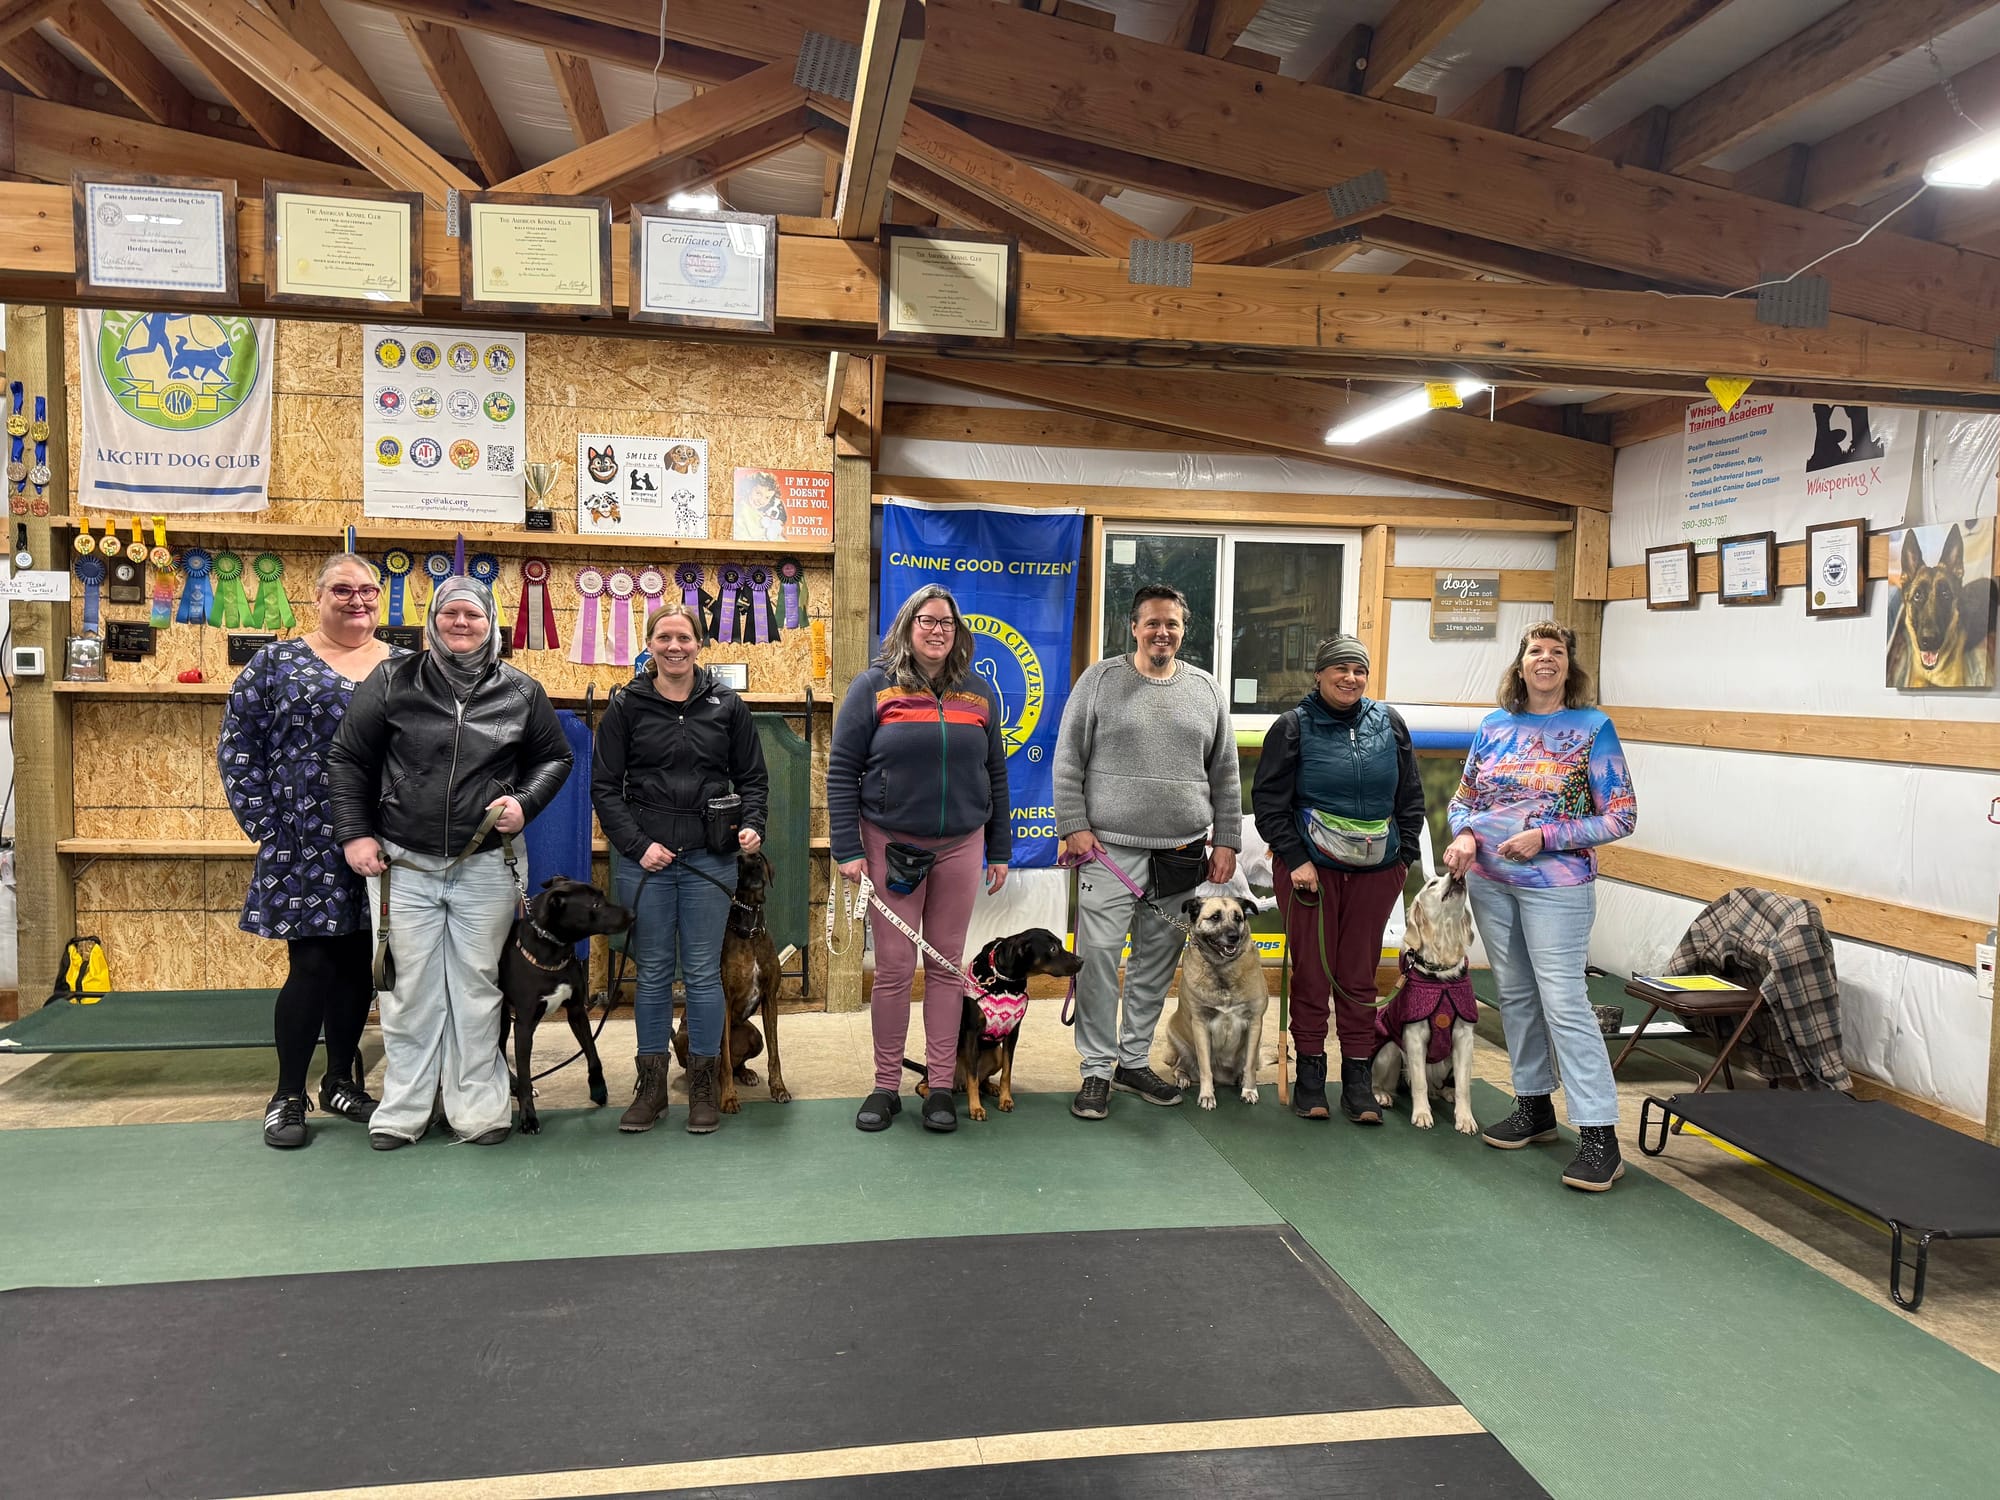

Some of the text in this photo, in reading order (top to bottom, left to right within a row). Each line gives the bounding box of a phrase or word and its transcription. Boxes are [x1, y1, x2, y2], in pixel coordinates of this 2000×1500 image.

[103, 193, 128, 201] Cascade
[128, 194, 159, 203] Australian
[179, 198, 190, 206] Dog
[661, 233, 710, 247] Certificate
[712, 238, 724, 248] of
[128, 245, 150, 254] Herding
[166, 391, 192, 415] AKC
[1689, 403, 1774, 433] Training Academy
[1749, 428, 1768, 438] Group
[418, 445, 433, 458] ATT
[626, 452, 658, 460] SMILES
[1714, 448, 1740, 458] classes!
[97, 447, 260, 469] AKC FIT DOG CLUB
[1712, 458, 1746, 470] Obedience,
[1745, 469, 1763, 478] Issues
[785, 477, 830, 487] IF MY DOG
[1746, 480, 1761, 488] Good
[1807, 466, 1882, 500] Whispering X
[790, 488, 825, 498] DOESN'T
[421, 497, 469, 507] cgc@akc.org
[786, 499, 808, 508] LIKE
[1689, 503, 1700, 511] and
[1701, 500, 1714, 509] Trick
[792, 516, 823, 526] I DON'T
[786, 526, 808, 536] LIKE
[889, 552, 951, 571] CANINE
[955, 558, 1004, 573] GOOD
[1443, 573, 1479, 599] dogs
[1465, 607, 1481, 615] they
[1005, 632, 1041, 708] CITIZEN
[1253, 940, 1280, 950] ogs
